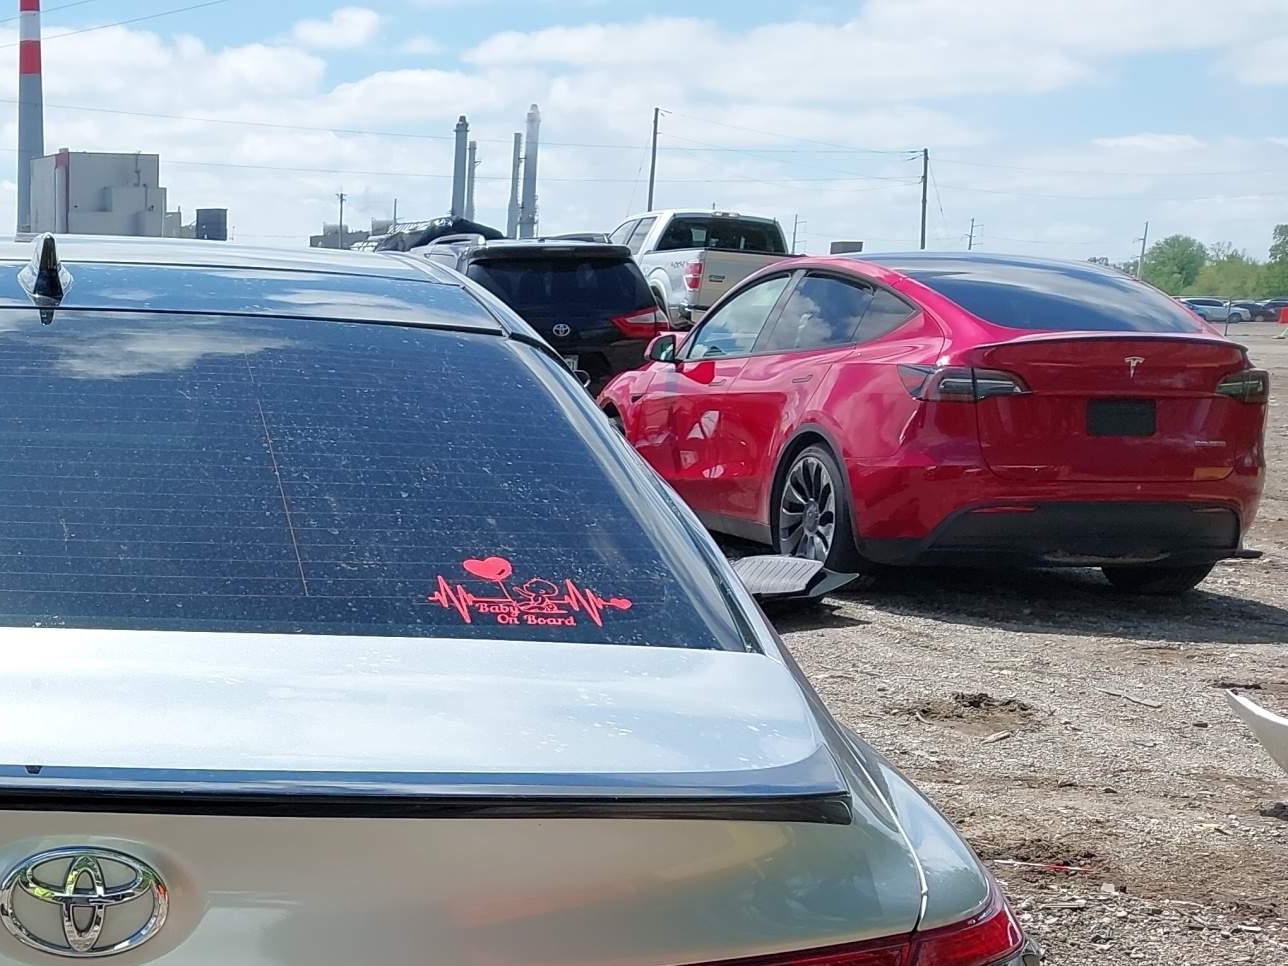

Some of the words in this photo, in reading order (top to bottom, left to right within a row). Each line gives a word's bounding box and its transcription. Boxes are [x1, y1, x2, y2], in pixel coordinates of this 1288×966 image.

[475, 602, 520, 616] Baby
[497, 614, 520, 625] On
[524, 614, 576, 626] Board
